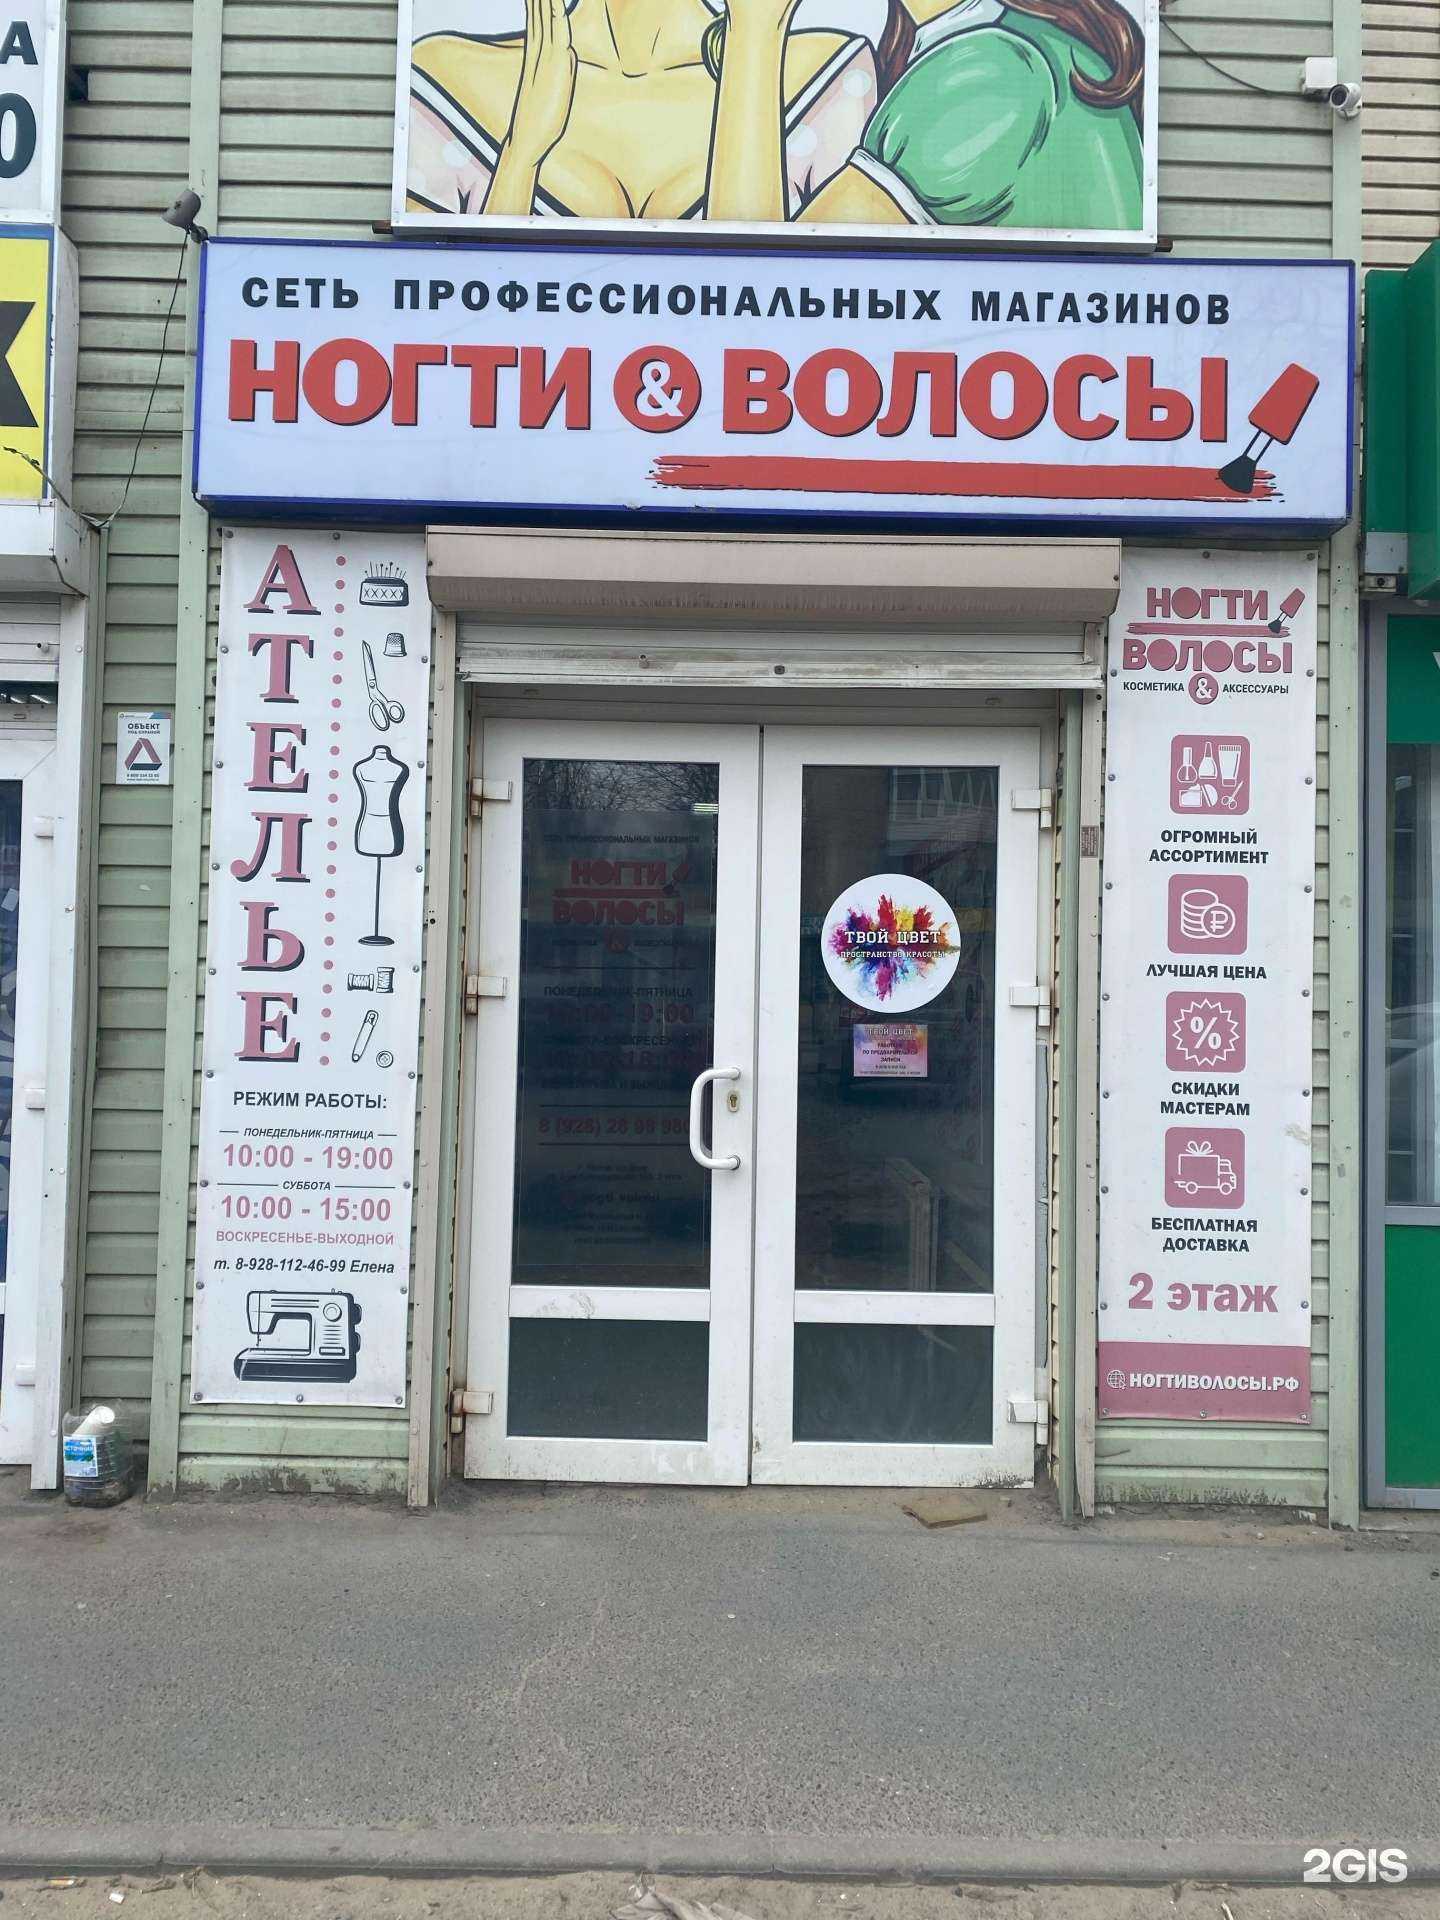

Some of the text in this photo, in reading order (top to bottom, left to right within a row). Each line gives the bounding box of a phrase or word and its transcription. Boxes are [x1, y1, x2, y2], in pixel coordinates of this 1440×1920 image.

[241, 276, 1231, 325] СЕТЬ ПРОФЕССИОНАЛЬНЫХ МАГАЗИНОВ
[228, 337, 592, 430] НОГТИ
[722, 347, 1229, 443] ВОЛОСЫ
[1146, 586, 1269, 621] НОГТИ
[1122, 637, 1293, 674] ВОЛОСЫ
[1122, 682, 1185, 694] КОСМЕТИКА
[1222, 683, 1290, 695] АКСЕССУАРЫ
[230, 543, 321, 1063] АТЕЛЬЕ
[1160, 827, 1258, 845] ОГРОМНЫЙ
[1148, 849, 1269, 865] АССОРТИМЕНТ
[570, 859, 668, 886] НОГТИ
[552, 900, 685, 926] ВОЛОСЫ
[844, 928, 941, 946] ТВОЙ ЦВЕТ
[905, 950, 945, 958] КРАСОТЫ
[1146, 964, 1267, 981] ЛУЧШАЯ ЦЕНА
[1170, 1081, 1241, 1098] СКИДКИ
[232, 1091, 388, 1109] РЕЖИМ РАБОТЫ:
[1159, 1100, 1251, 1116] МАСТЕРАМ
[243, 1127, 375, 1141] ПОНЕДЕЛЬНИК-ПЯТНИЦА
[223, 1143, 294, 1169] 10:00
[320, 1145, 393, 1170] 19:00
[282, 1180, 331, 1191] СУББОТА
[220, 1195, 292, 1220] 10:00
[319, 1197, 391, 1222] 15:00
[1151, 1217, 1258, 1233] БЕСПЛАТНАЯ
[215, 1230, 394, 1245] ВОСКРЕСЕНЬЕ-ВЫХОДНОЙ
[1162, 1237, 1250, 1254] ДОСТАВКА
[235, 1257, 346, 1273] 8-928-112-46-99
[350, 1260, 395, 1274] Елена
[1127, 1271, 1280, 1313] 2 этаж
[1129, 1372, 1300, 1393] НОГТИВОЛОСЫ.РФ
